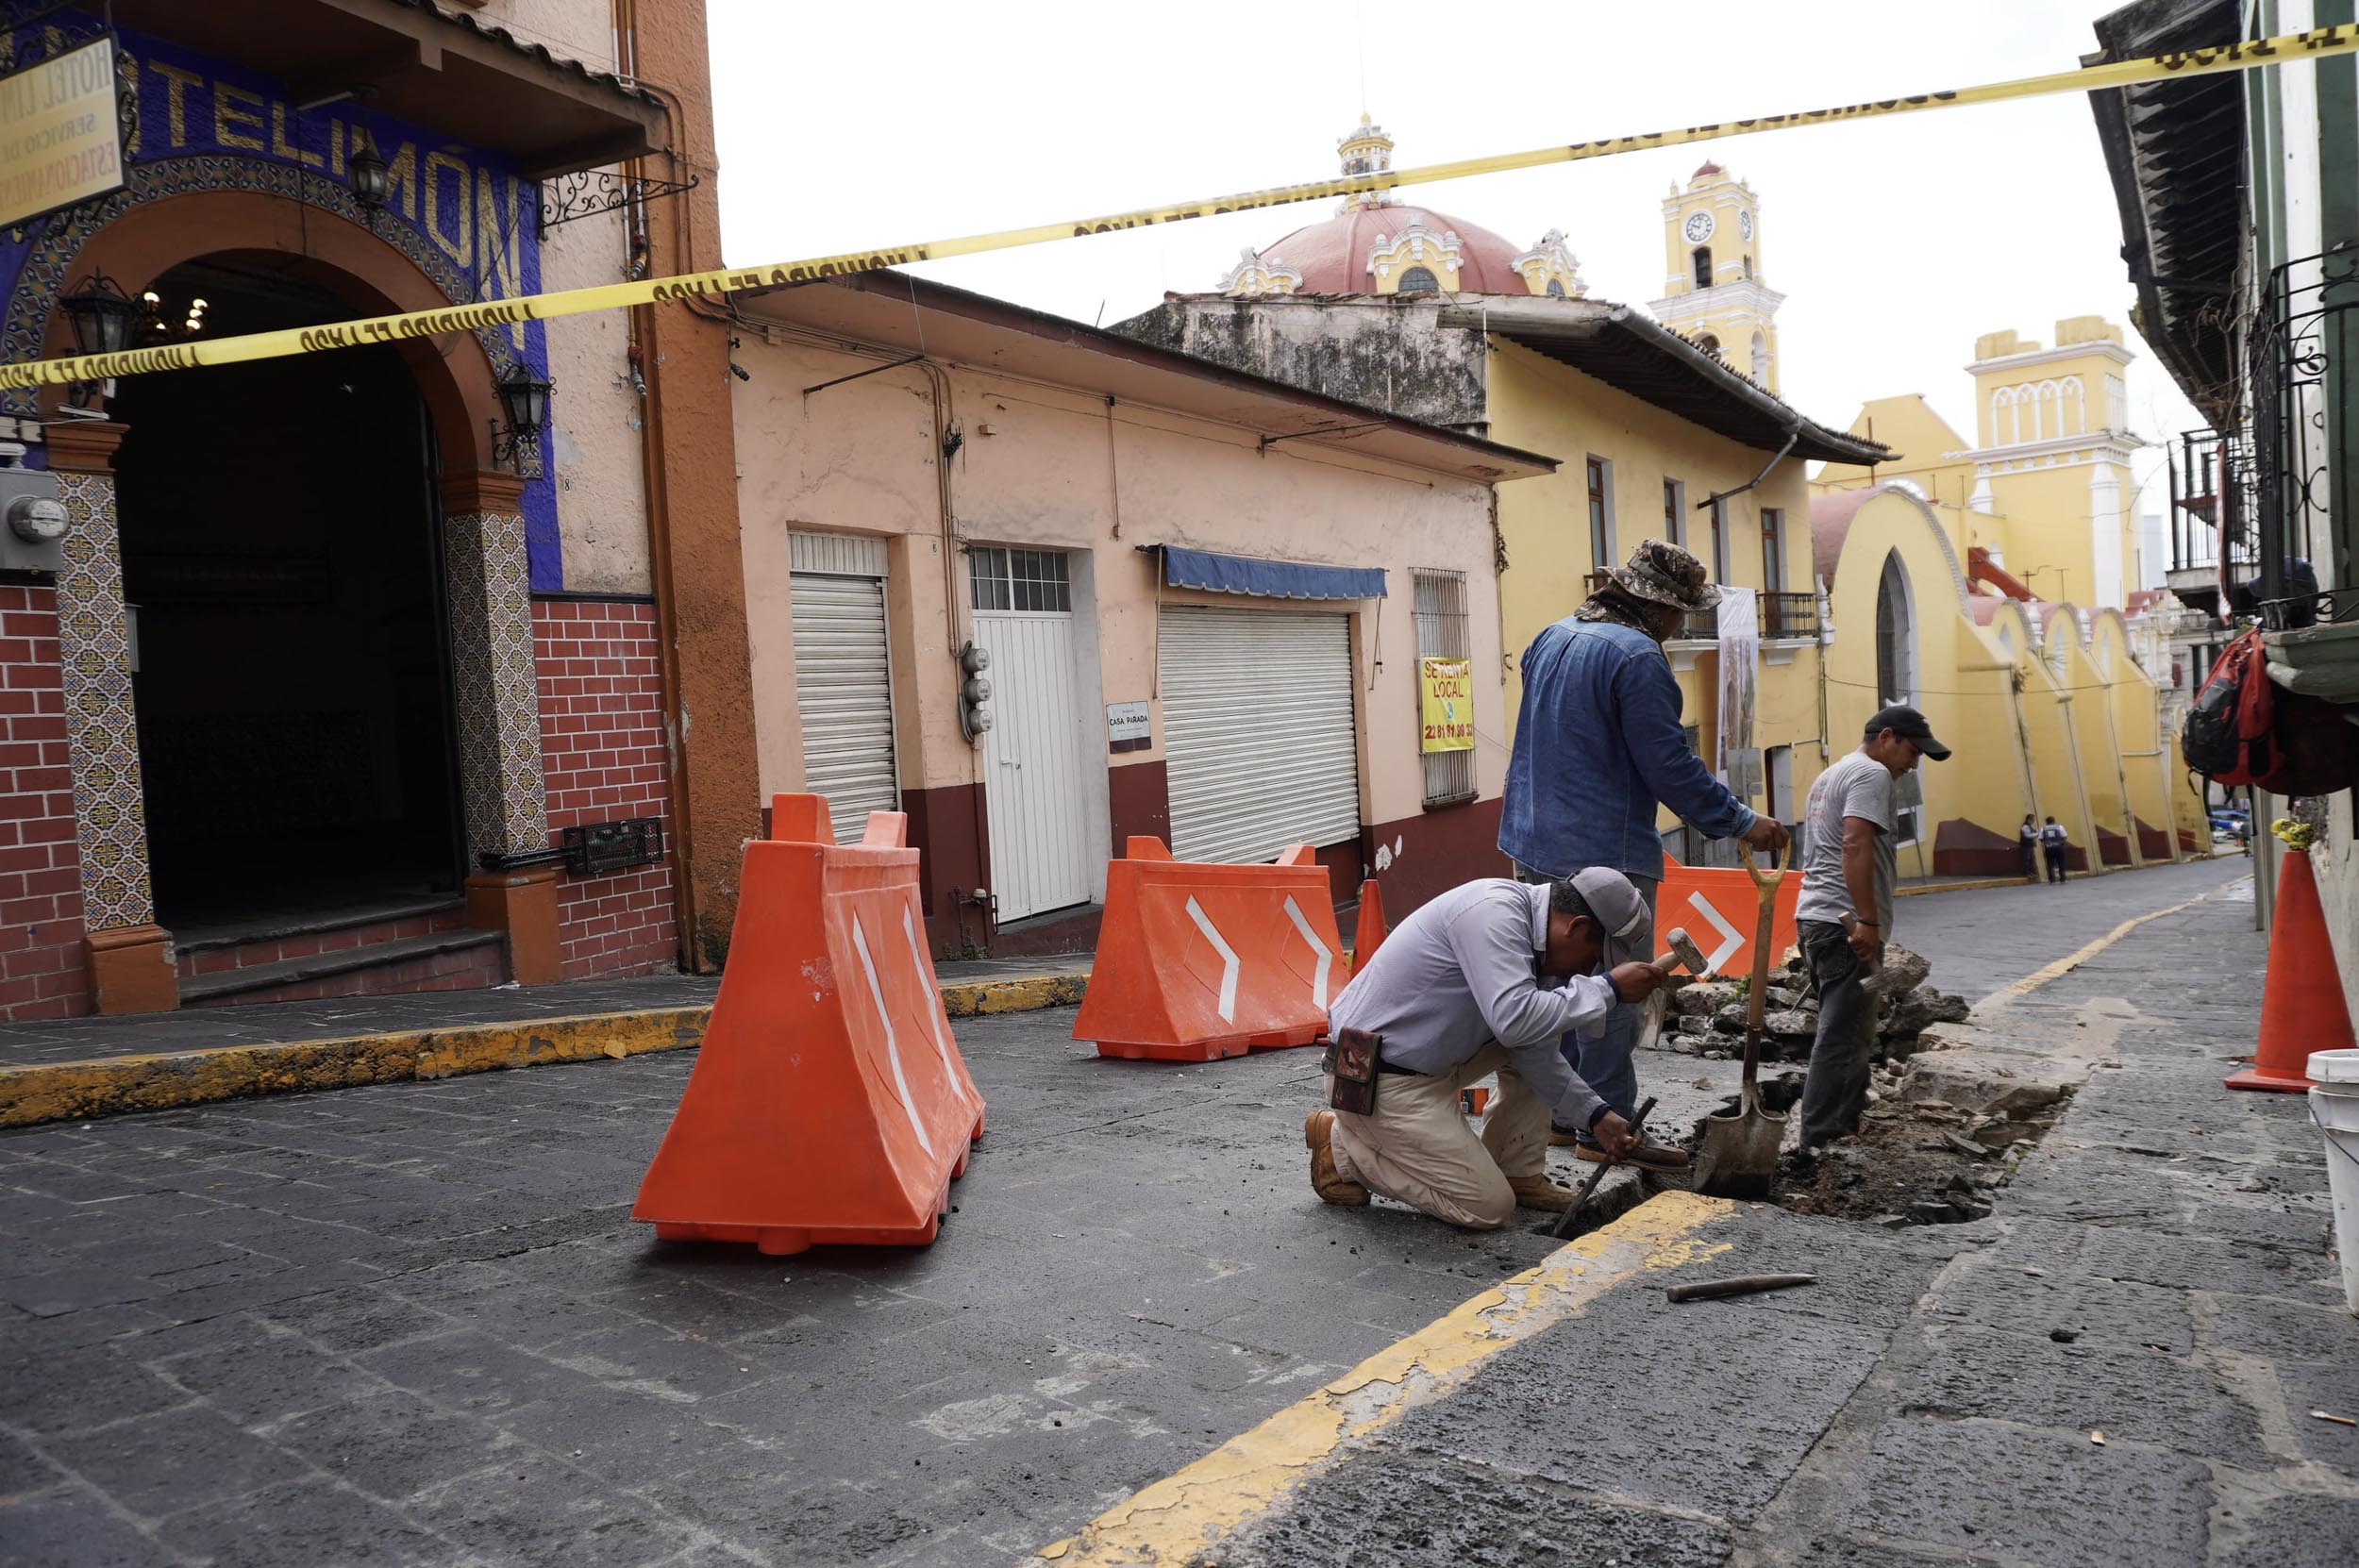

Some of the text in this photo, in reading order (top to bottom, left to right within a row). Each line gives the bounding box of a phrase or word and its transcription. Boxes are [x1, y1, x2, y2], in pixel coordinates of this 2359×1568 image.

[1425, 661, 1438, 678] SE
[1434, 680, 1464, 698] LOCAL
[1110, 714, 1147, 726] CASA PARADA
